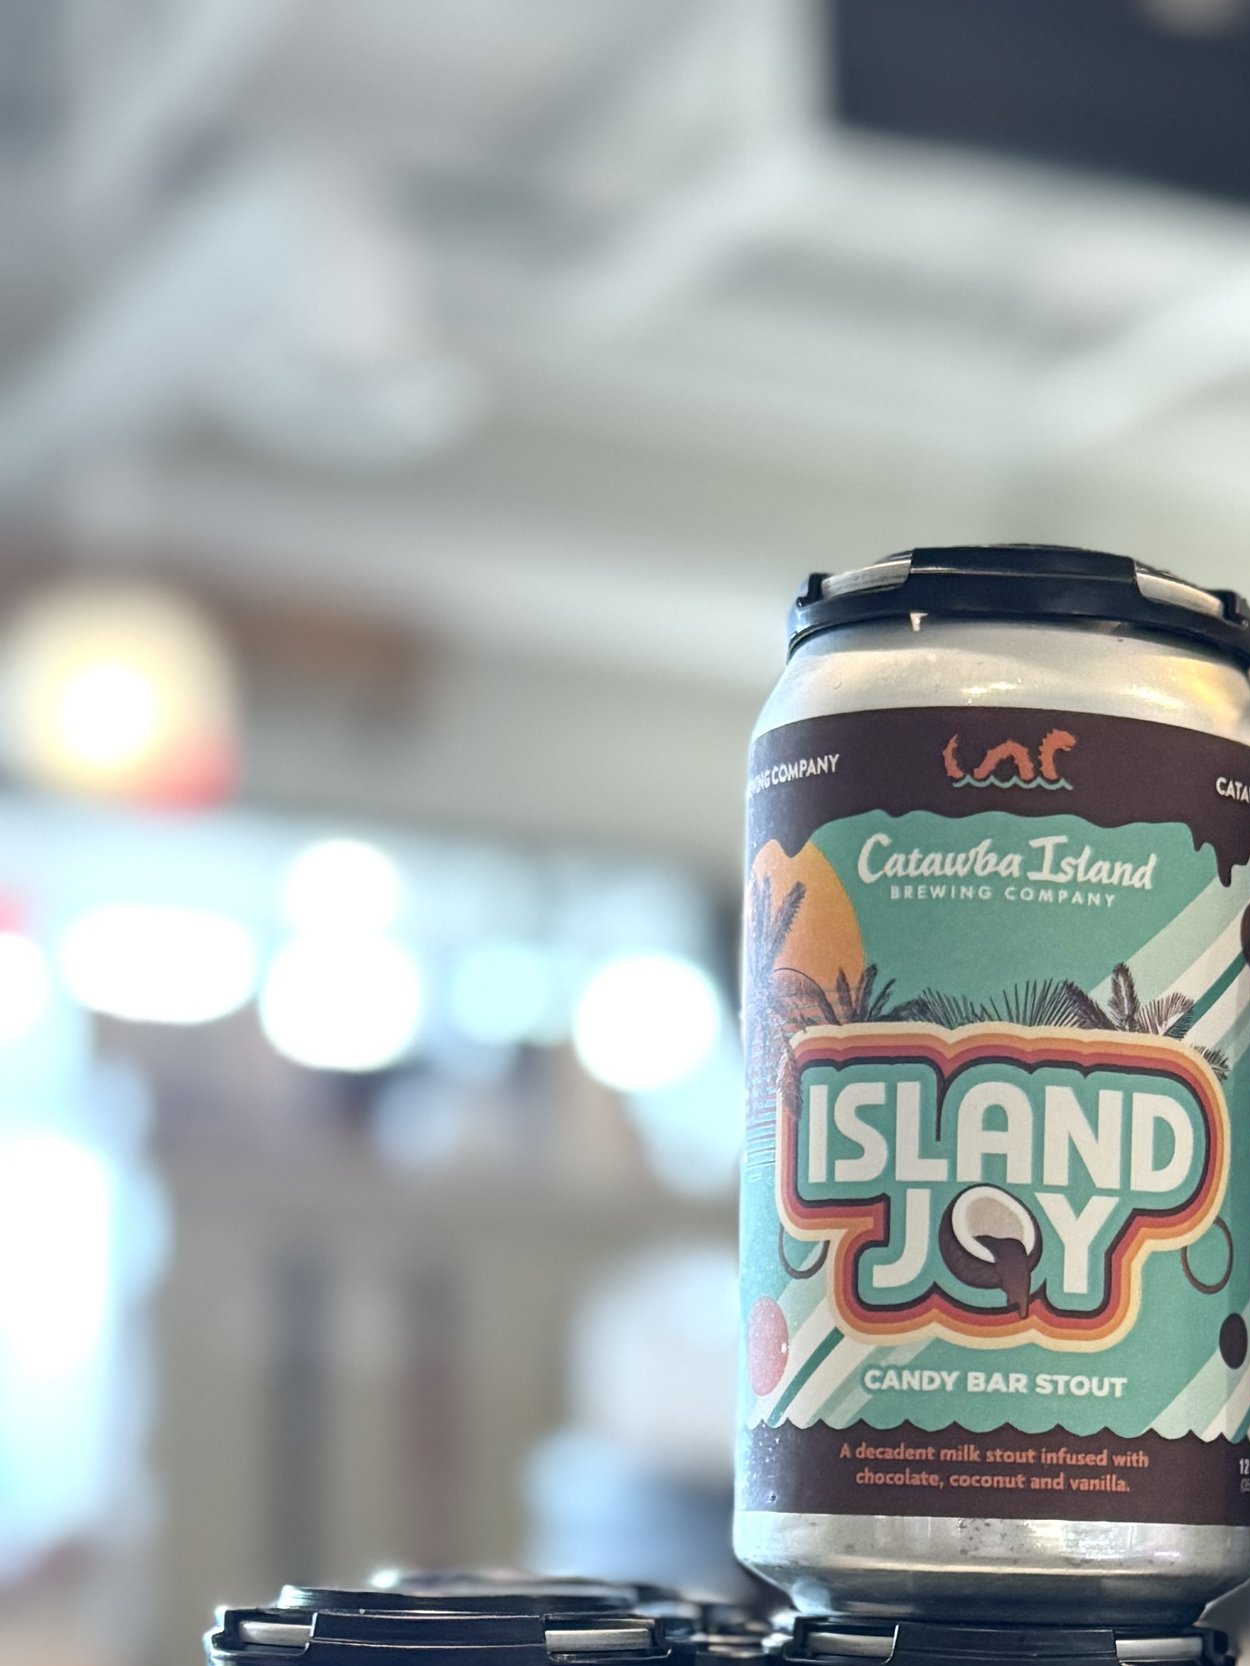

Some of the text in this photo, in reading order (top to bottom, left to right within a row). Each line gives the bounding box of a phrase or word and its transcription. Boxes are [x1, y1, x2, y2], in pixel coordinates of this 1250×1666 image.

[771, 753, 840, 785] COMPANY
[857, 833, 1157, 889] Catawba Island
[890, 885, 1116, 908] BREWING COMPANY
[808, 1081, 1193, 1193] ISLAND
[872, 1184, 1120, 1302] JOY
[863, 1369, 1128, 1398] CANDY BAR STOUT
[840, 1443, 1149, 1468] A decadent milk stout infused with
[856, 1468, 1131, 1492] chocolate, coconut and vanilla.
